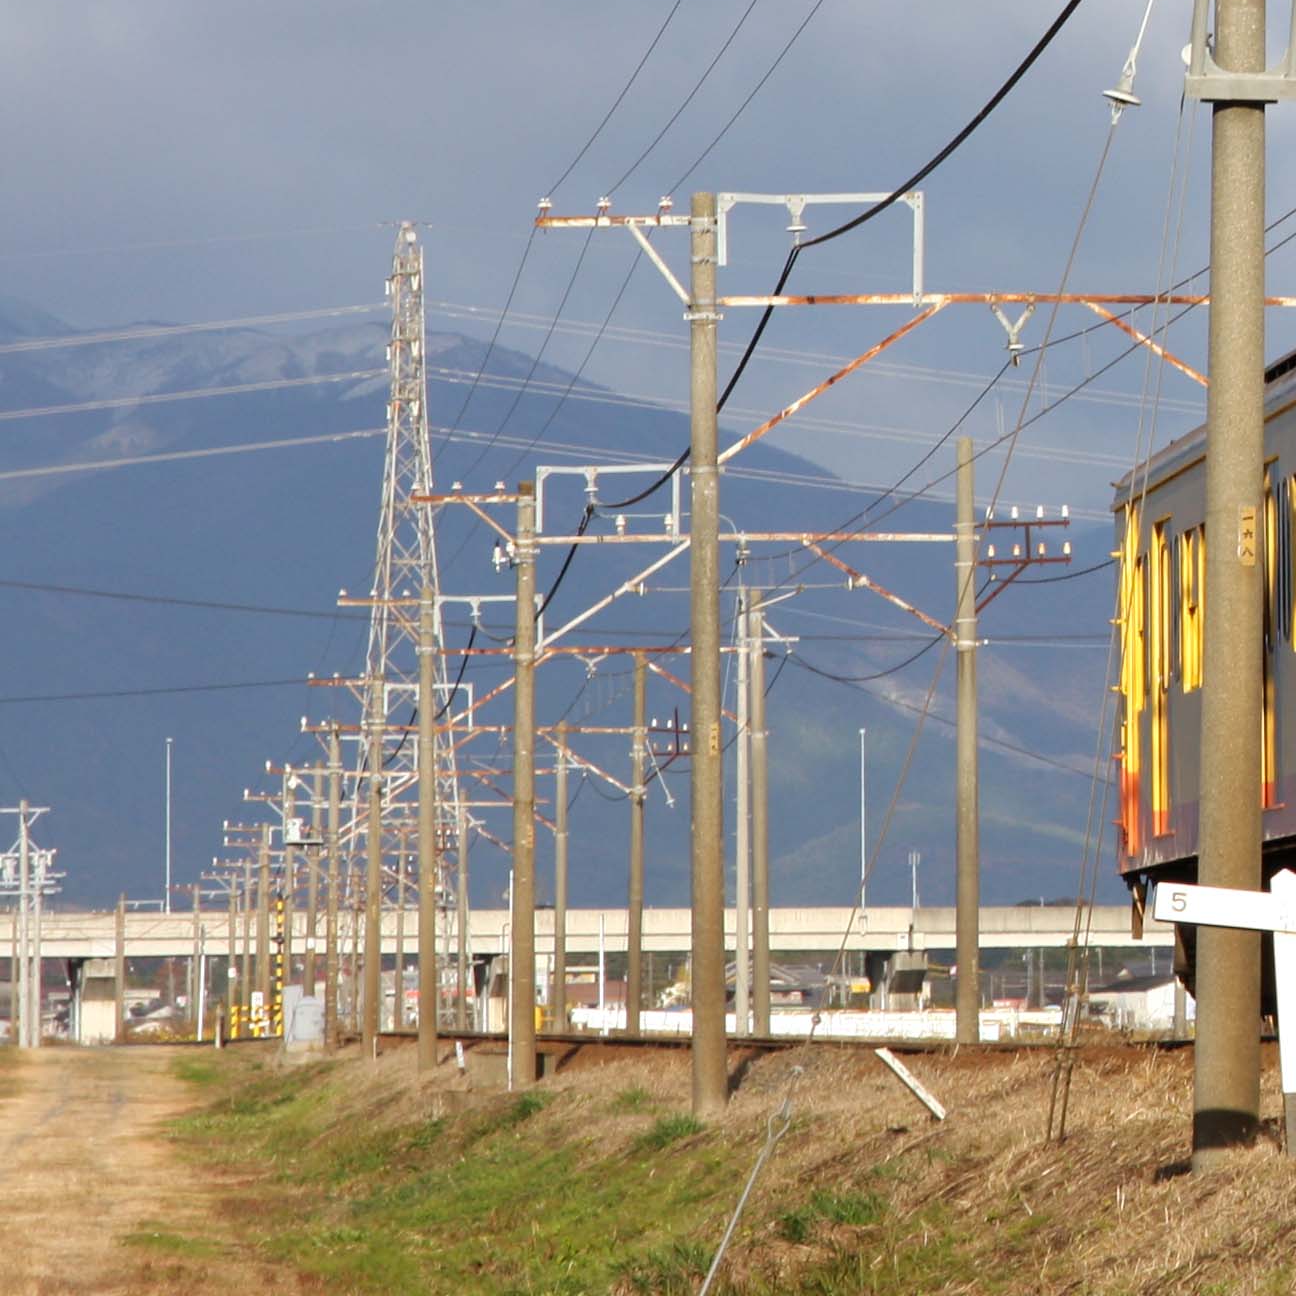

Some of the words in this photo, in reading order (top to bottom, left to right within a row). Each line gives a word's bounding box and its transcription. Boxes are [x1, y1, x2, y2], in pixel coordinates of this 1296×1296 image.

[1241, 515, 1254, 557] 一六八
[1171, 891, 1188, 913] 5
